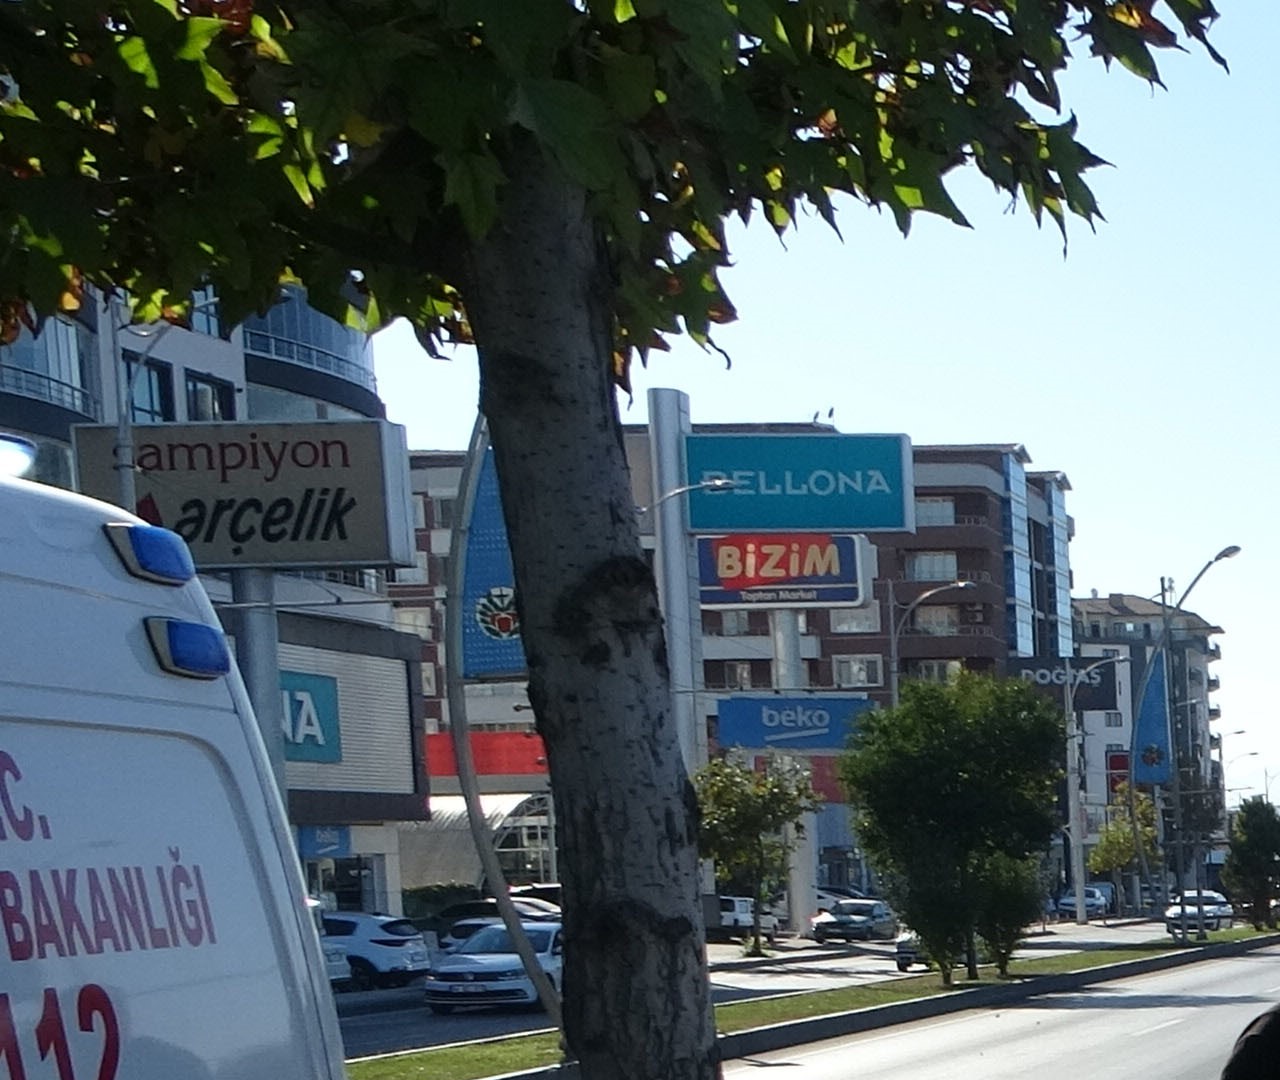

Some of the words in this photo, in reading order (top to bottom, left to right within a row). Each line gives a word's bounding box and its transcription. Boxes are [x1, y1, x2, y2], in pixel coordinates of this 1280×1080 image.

[174, 487, 357, 555] arçelik
[739, 590, 777, 602] Toptan
[779, 589, 817, 600] Market
[762, 705, 830, 728] beko
[0, 846, 216, 961] BAKANLIĞI
